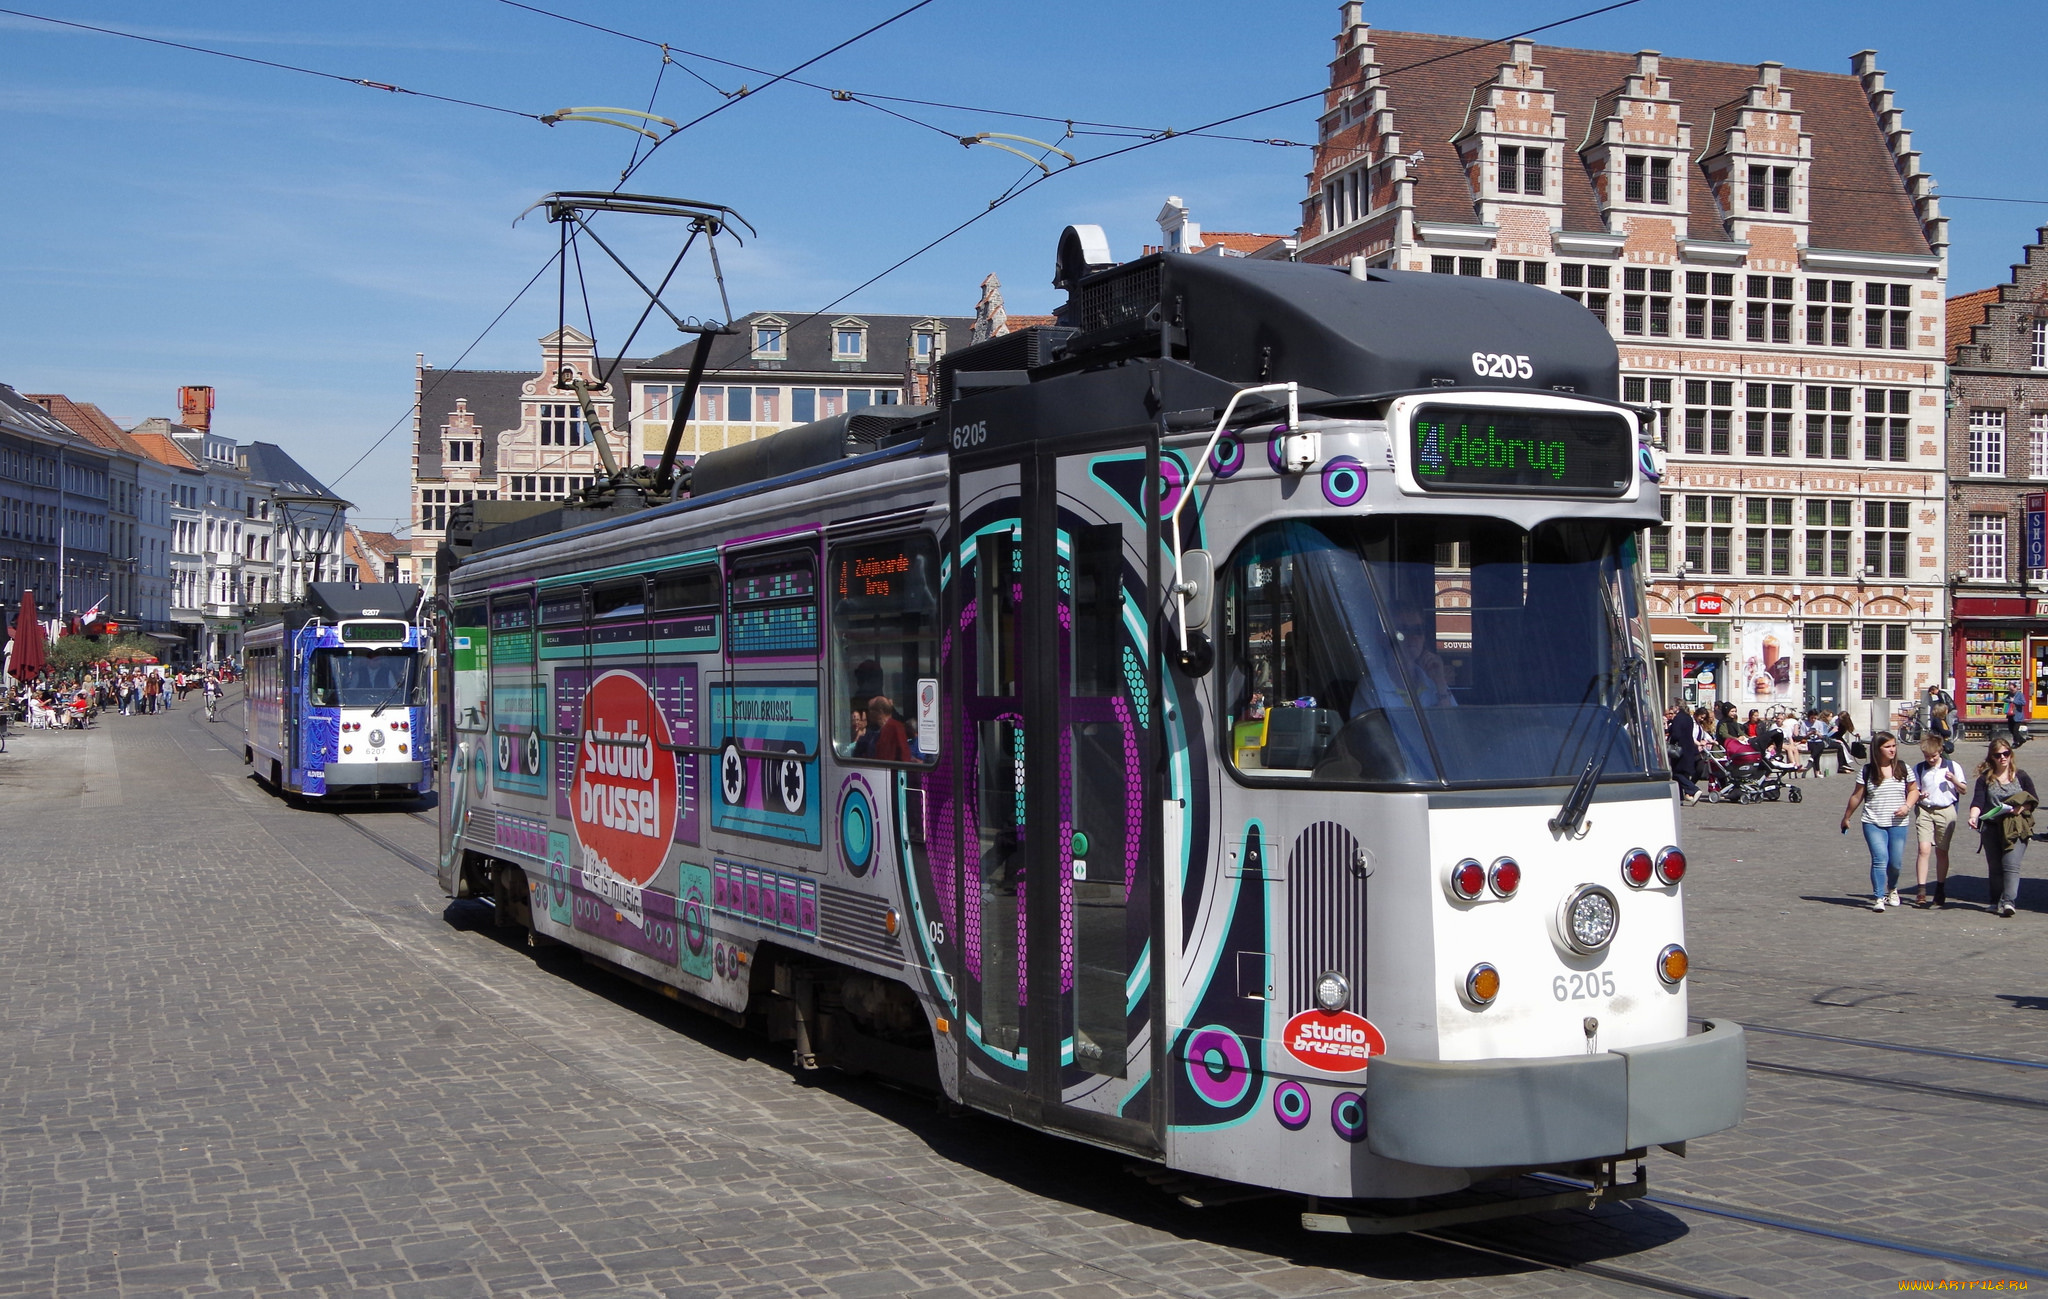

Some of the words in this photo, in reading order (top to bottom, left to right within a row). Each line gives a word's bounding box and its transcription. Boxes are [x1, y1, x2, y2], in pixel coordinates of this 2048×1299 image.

[1471, 352, 1533, 379] 6205
[953, 420, 987, 449] 6205
[1421, 426, 1443, 468] 4
[1449, 424, 1565, 480] debrug
[2031, 514, 2042, 566] SHOP
[839, 561, 848, 600] 4
[361, 608, 380, 616] 6207
[345, 626, 352, 638] 4
[355, 626, 401, 639] Moscou
[694, 624, 710, 632] SCALE
[734, 700, 759, 721] STUDIO
[760, 699, 794, 722] BRUSSEL
[584, 717, 653, 780] studio
[580, 767, 660, 838] brussel
[612, 880, 641, 918] music
[929, 920, 944, 945] 05
[1552, 970, 1616, 1001] 6205
[1300, 1021, 1366, 1044] studio
[1293, 1035, 1370, 1059] brussel
